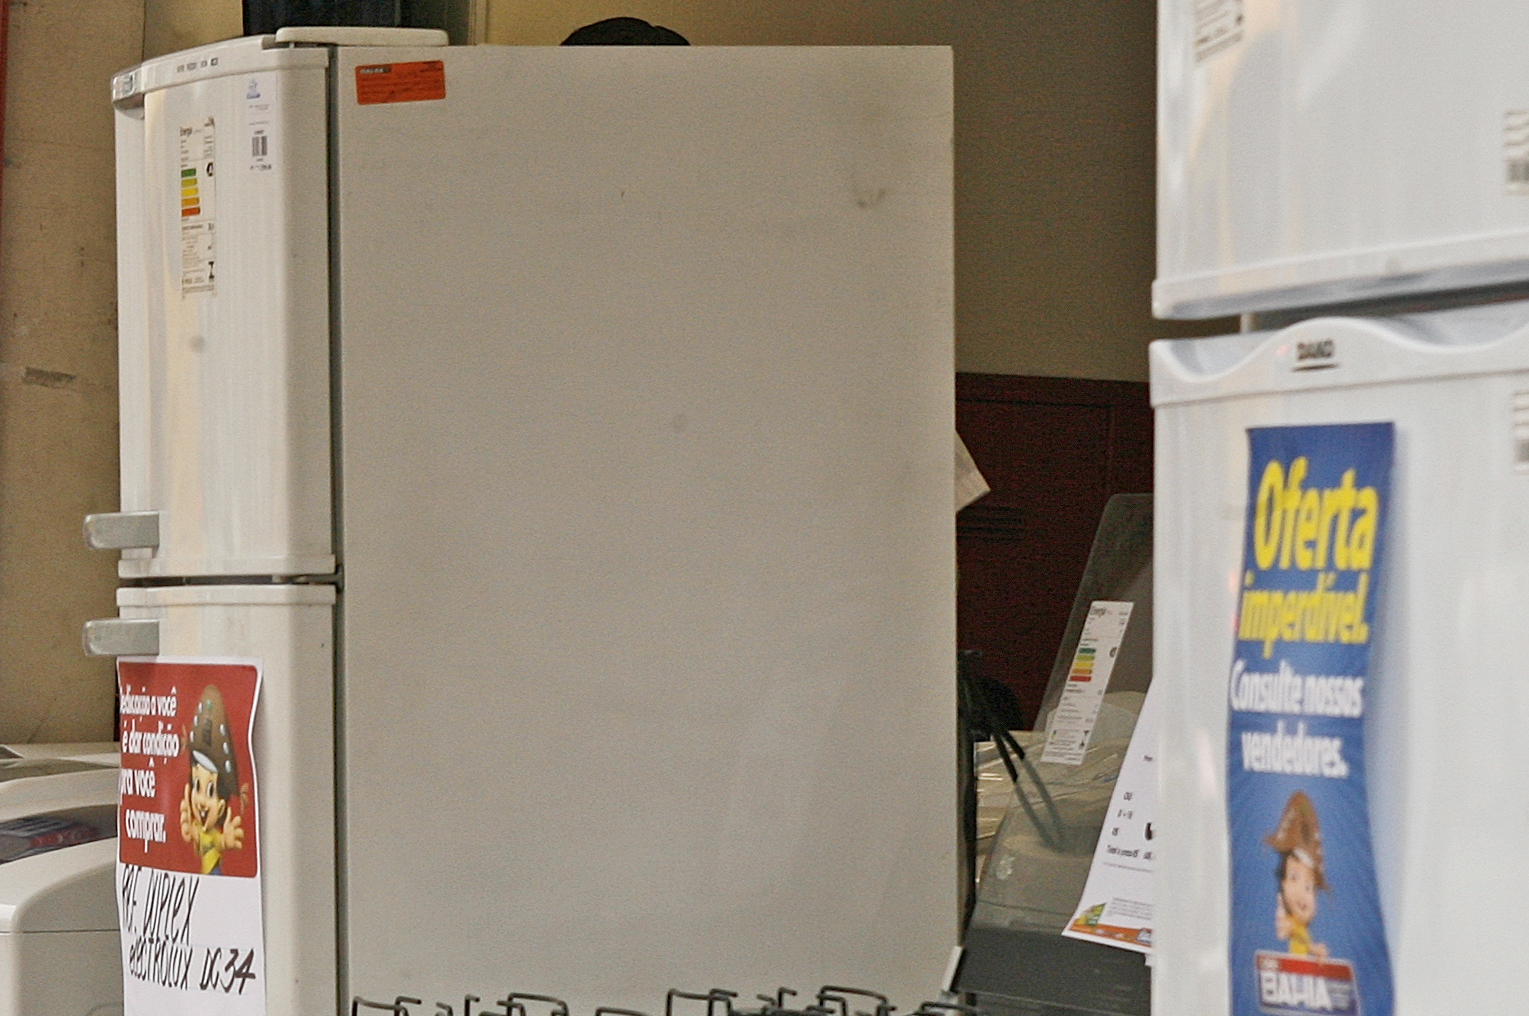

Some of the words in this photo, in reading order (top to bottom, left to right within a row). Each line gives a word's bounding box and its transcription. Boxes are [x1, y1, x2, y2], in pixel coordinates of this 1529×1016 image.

[1255, 456, 1379, 571] Oferta
[1238, 569, 1369, 660] imperdível.
[157, 686, 177, 717] você
[1230, 658, 1303, 715] Consulte
[1304, 675, 1364, 719] nossos
[122, 720, 128, 753] é
[129, 719, 142, 754] dar
[143, 720, 179, 765] condição
[1241, 719, 1349, 779] vendedores.
[134, 757, 156, 798] você
[126, 809, 167, 853] comprar.
